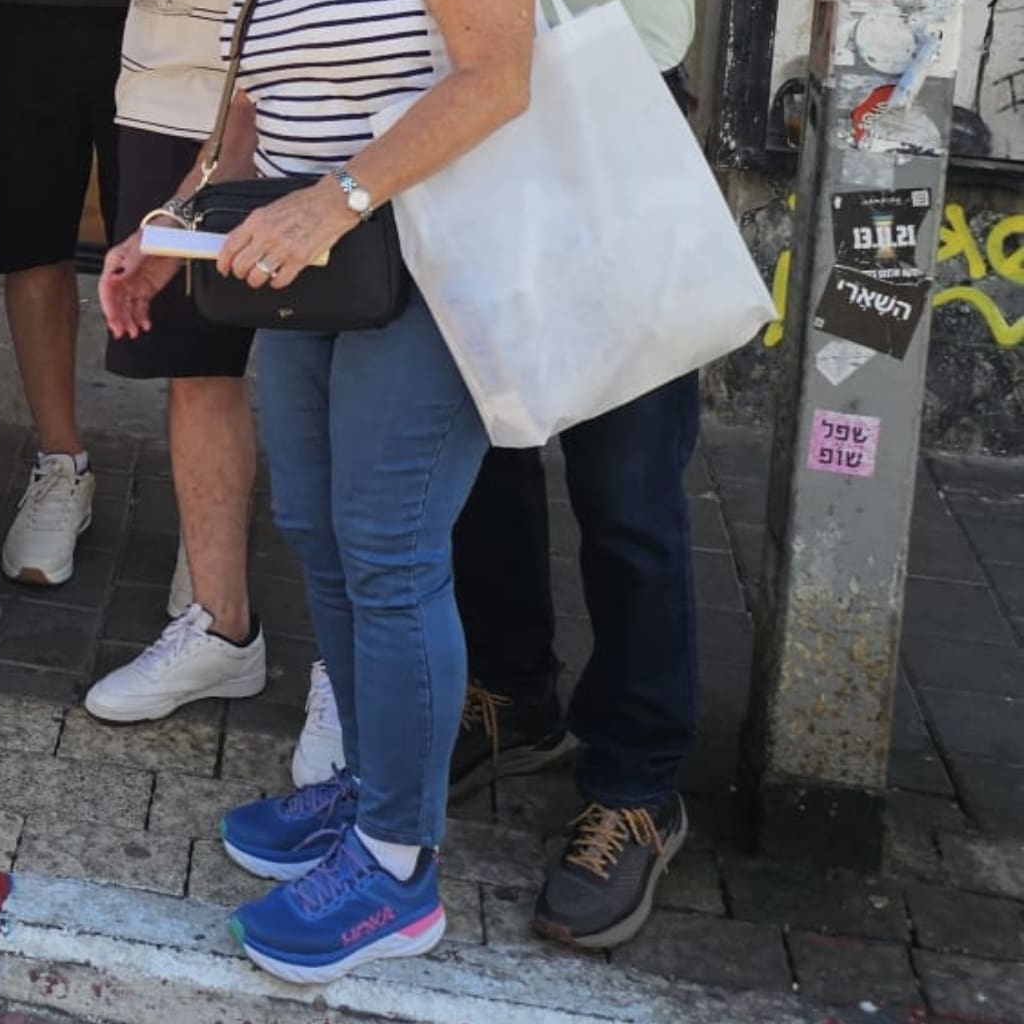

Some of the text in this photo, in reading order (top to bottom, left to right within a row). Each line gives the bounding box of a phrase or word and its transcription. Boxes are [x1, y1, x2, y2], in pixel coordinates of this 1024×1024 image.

[852, 224, 916, 250] 13.11.21
[821, 419, 868, 444] שפל
[818, 447, 863, 468] שופ
